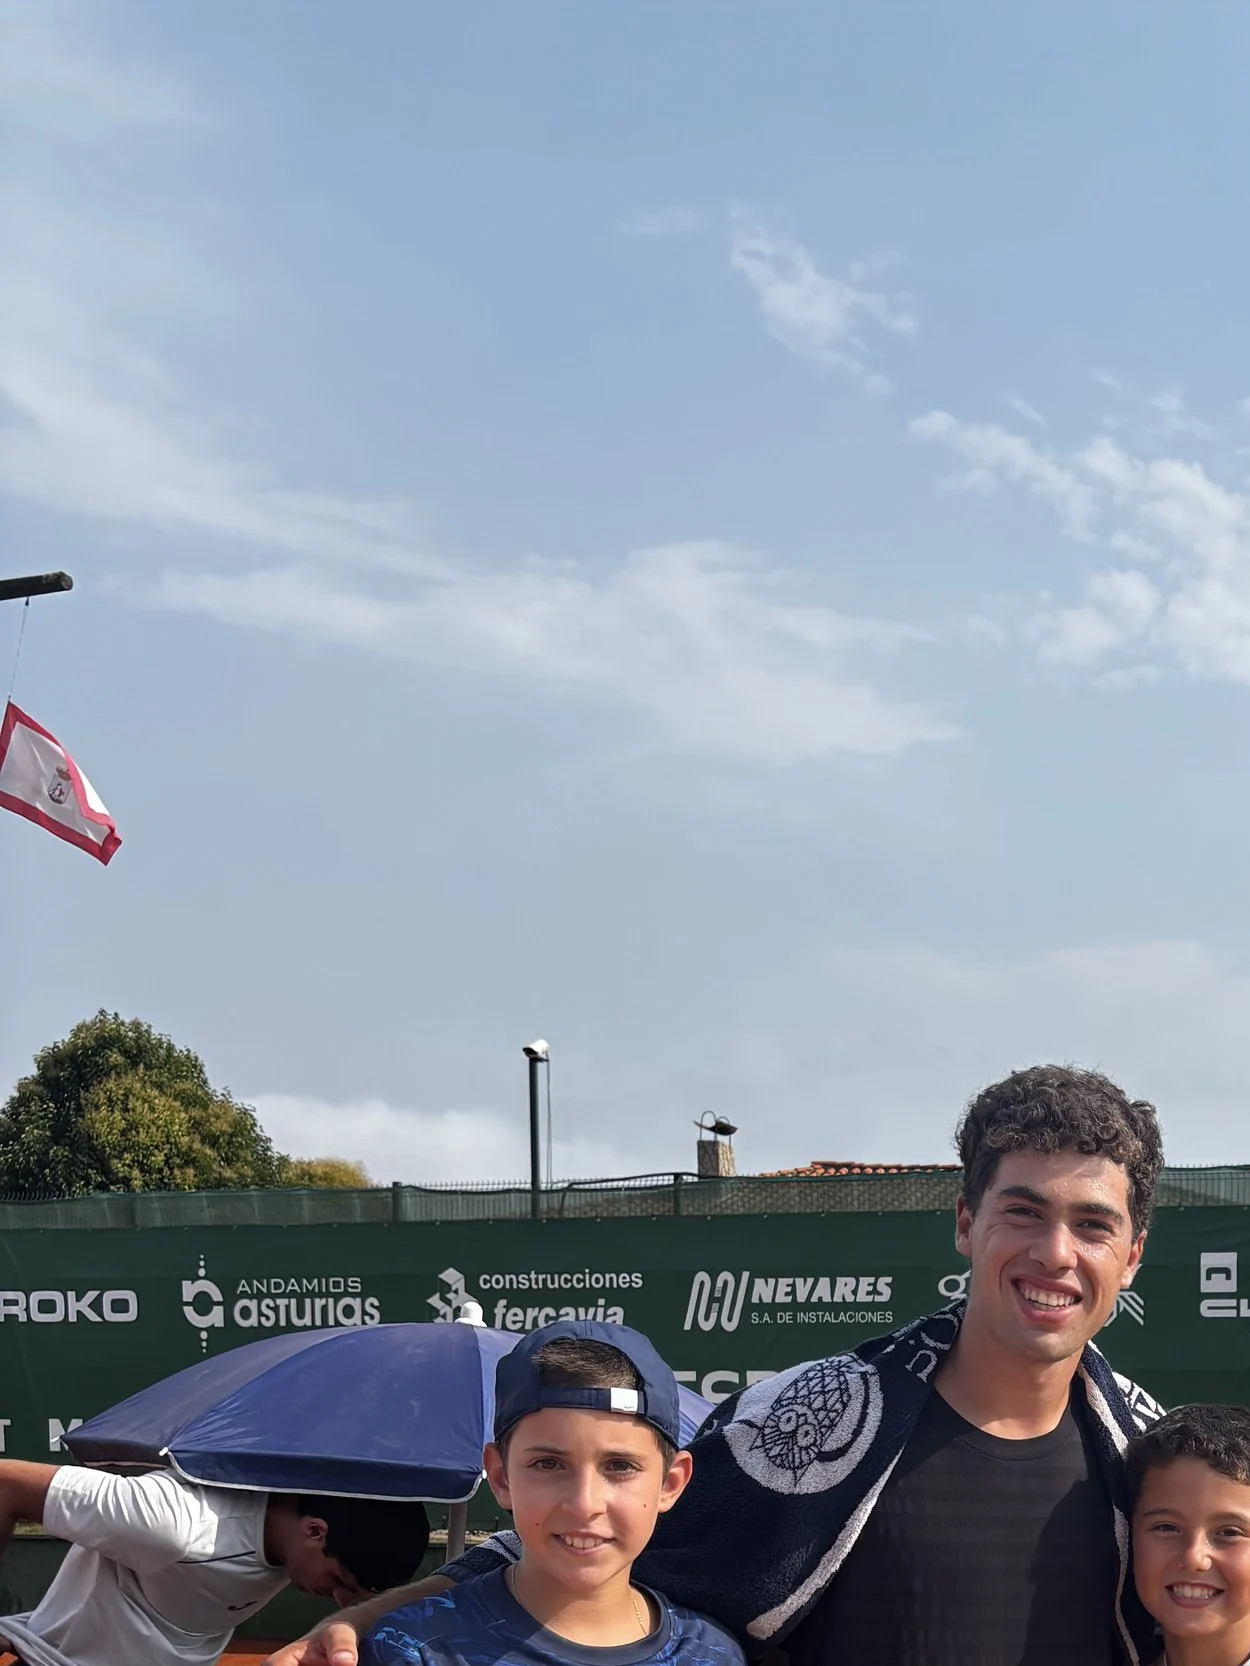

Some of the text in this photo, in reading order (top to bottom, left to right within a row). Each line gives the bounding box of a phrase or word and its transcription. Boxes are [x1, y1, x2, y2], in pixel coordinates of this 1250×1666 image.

[237, 1277, 362, 1294] ANDAMIOS
[479, 1269, 643, 1290] construcciones
[751, 1277, 893, 1303] NEVARES
[233, 1297, 381, 1328] asturias
[751, 1311, 893, 1323] S.A. DE INSTALACIONES
